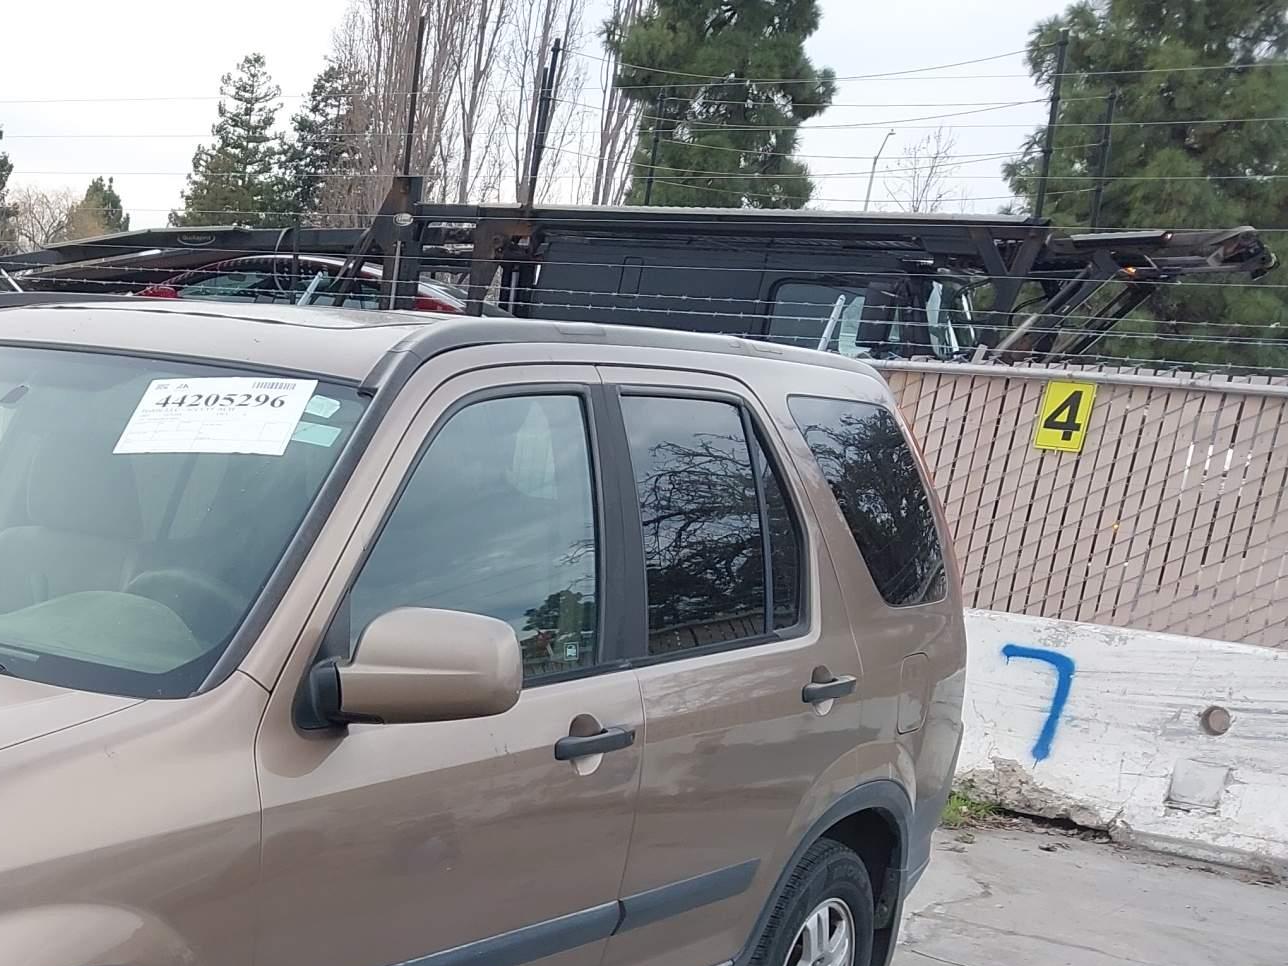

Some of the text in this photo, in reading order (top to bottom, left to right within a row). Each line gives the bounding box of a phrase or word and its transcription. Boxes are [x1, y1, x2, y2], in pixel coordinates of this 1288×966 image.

[155, 394, 289, 408] 44205296
[1043, 390, 1083, 441] 4
[1001, 643, 1075, 762] 7
